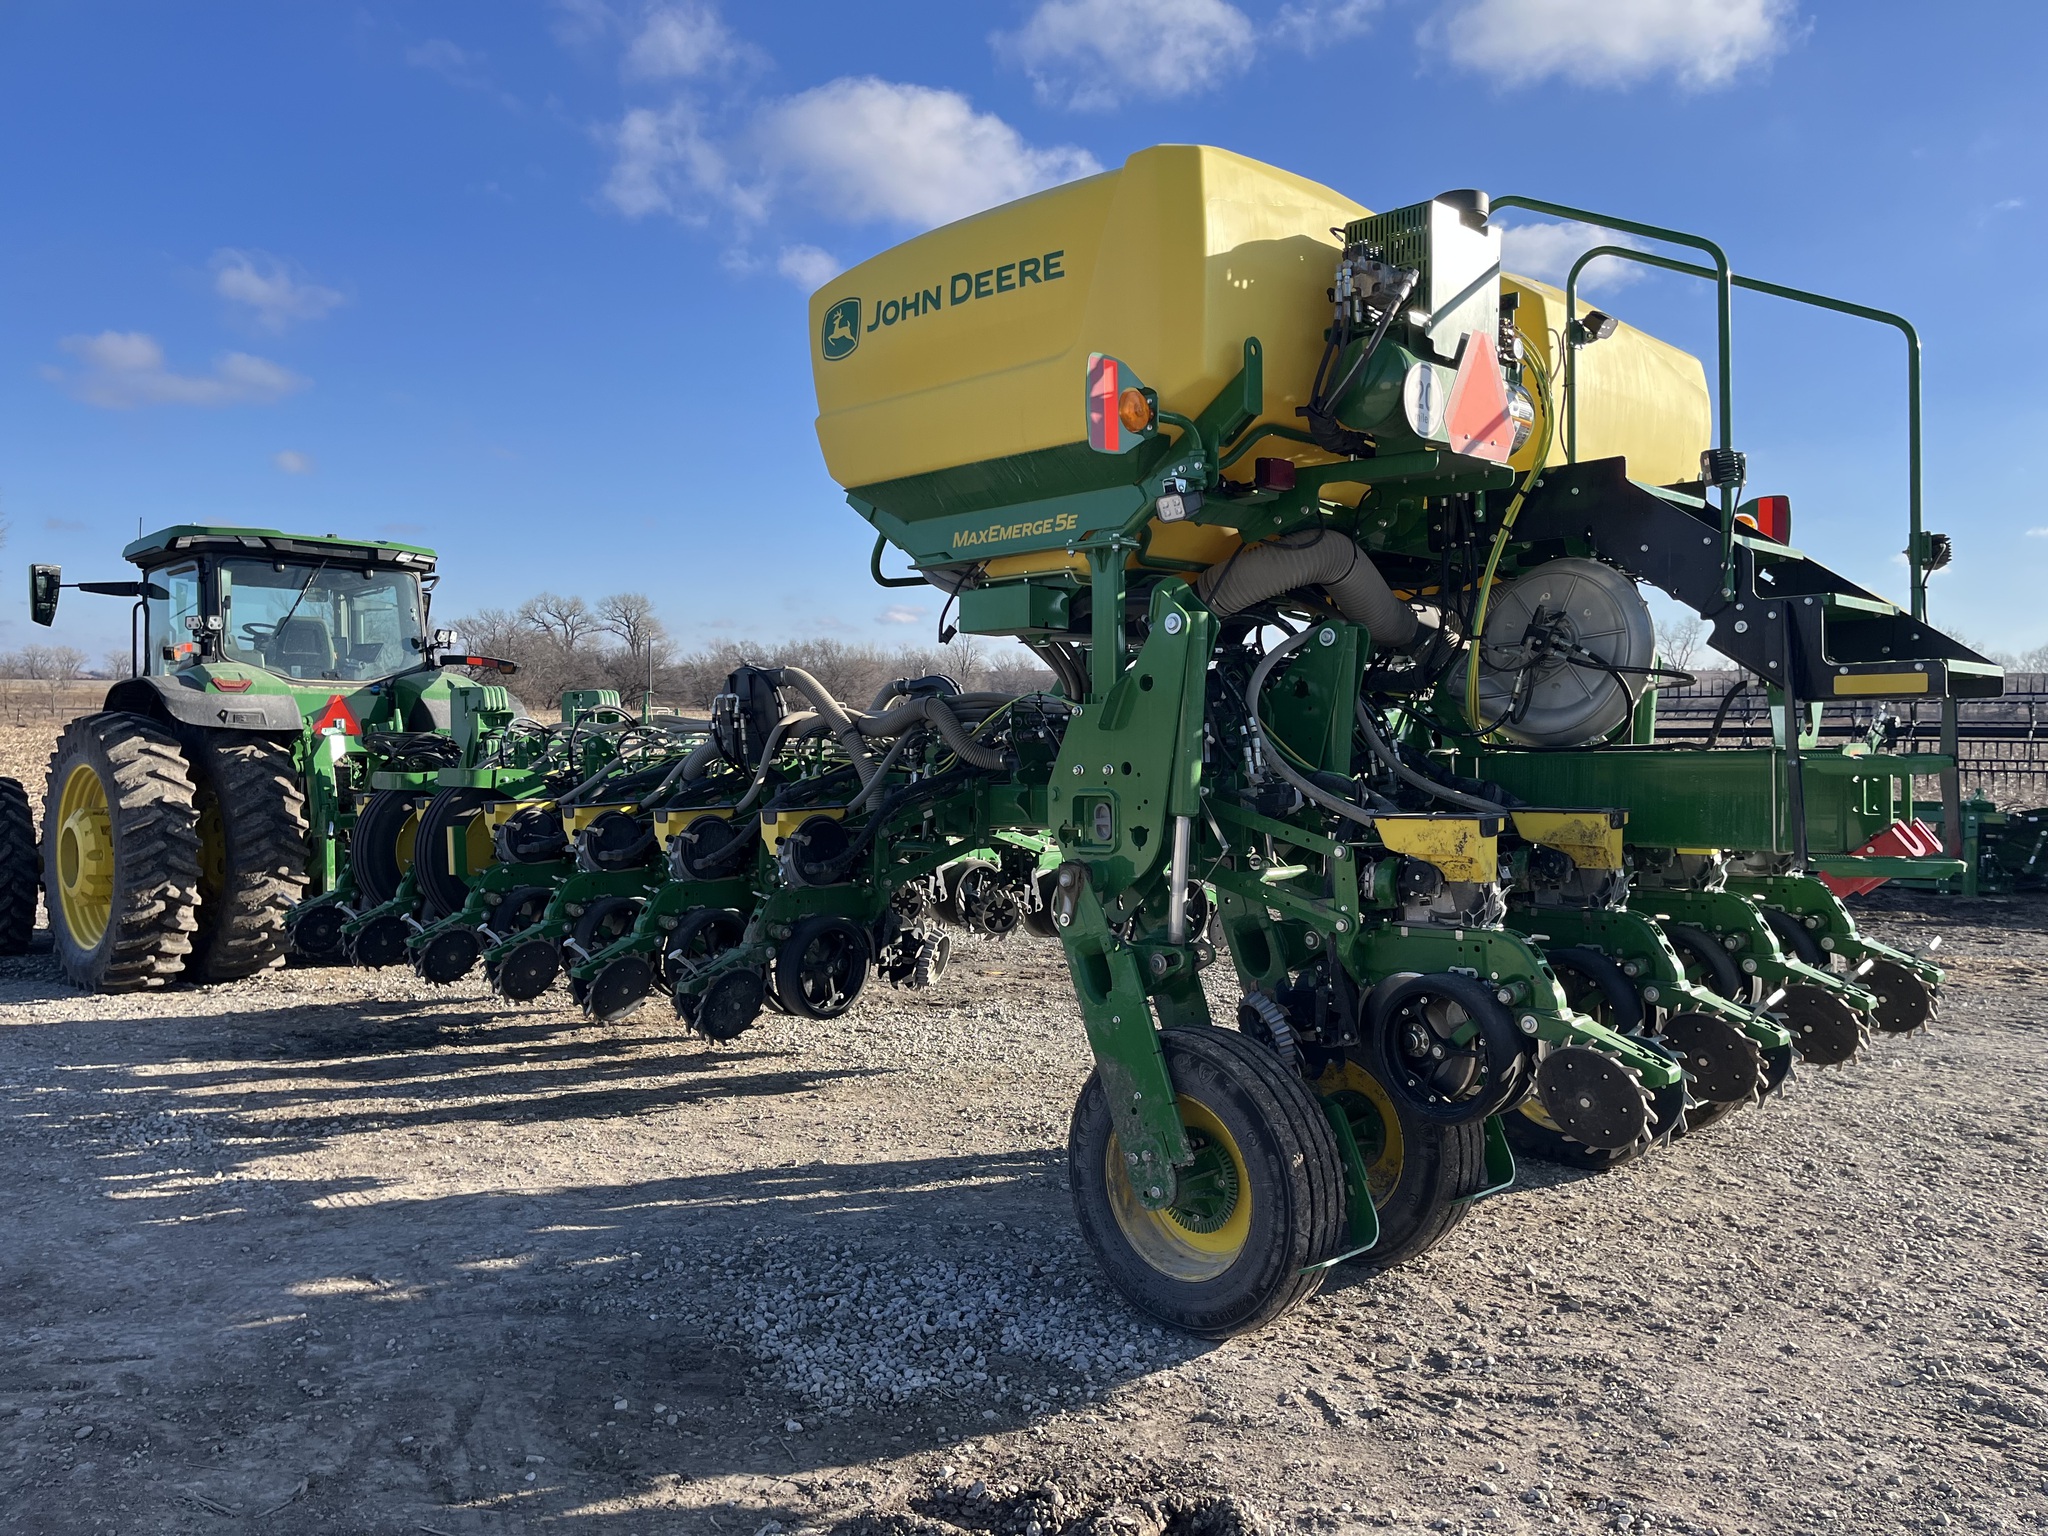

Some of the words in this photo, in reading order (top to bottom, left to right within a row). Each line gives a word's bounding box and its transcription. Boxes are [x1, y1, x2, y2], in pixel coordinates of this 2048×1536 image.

[866, 285, 942, 333] JOHN
[950, 249, 1065, 306] DEERE
[1416, 380, 1433, 412] 20
[1054, 513, 1079, 532] 5E
